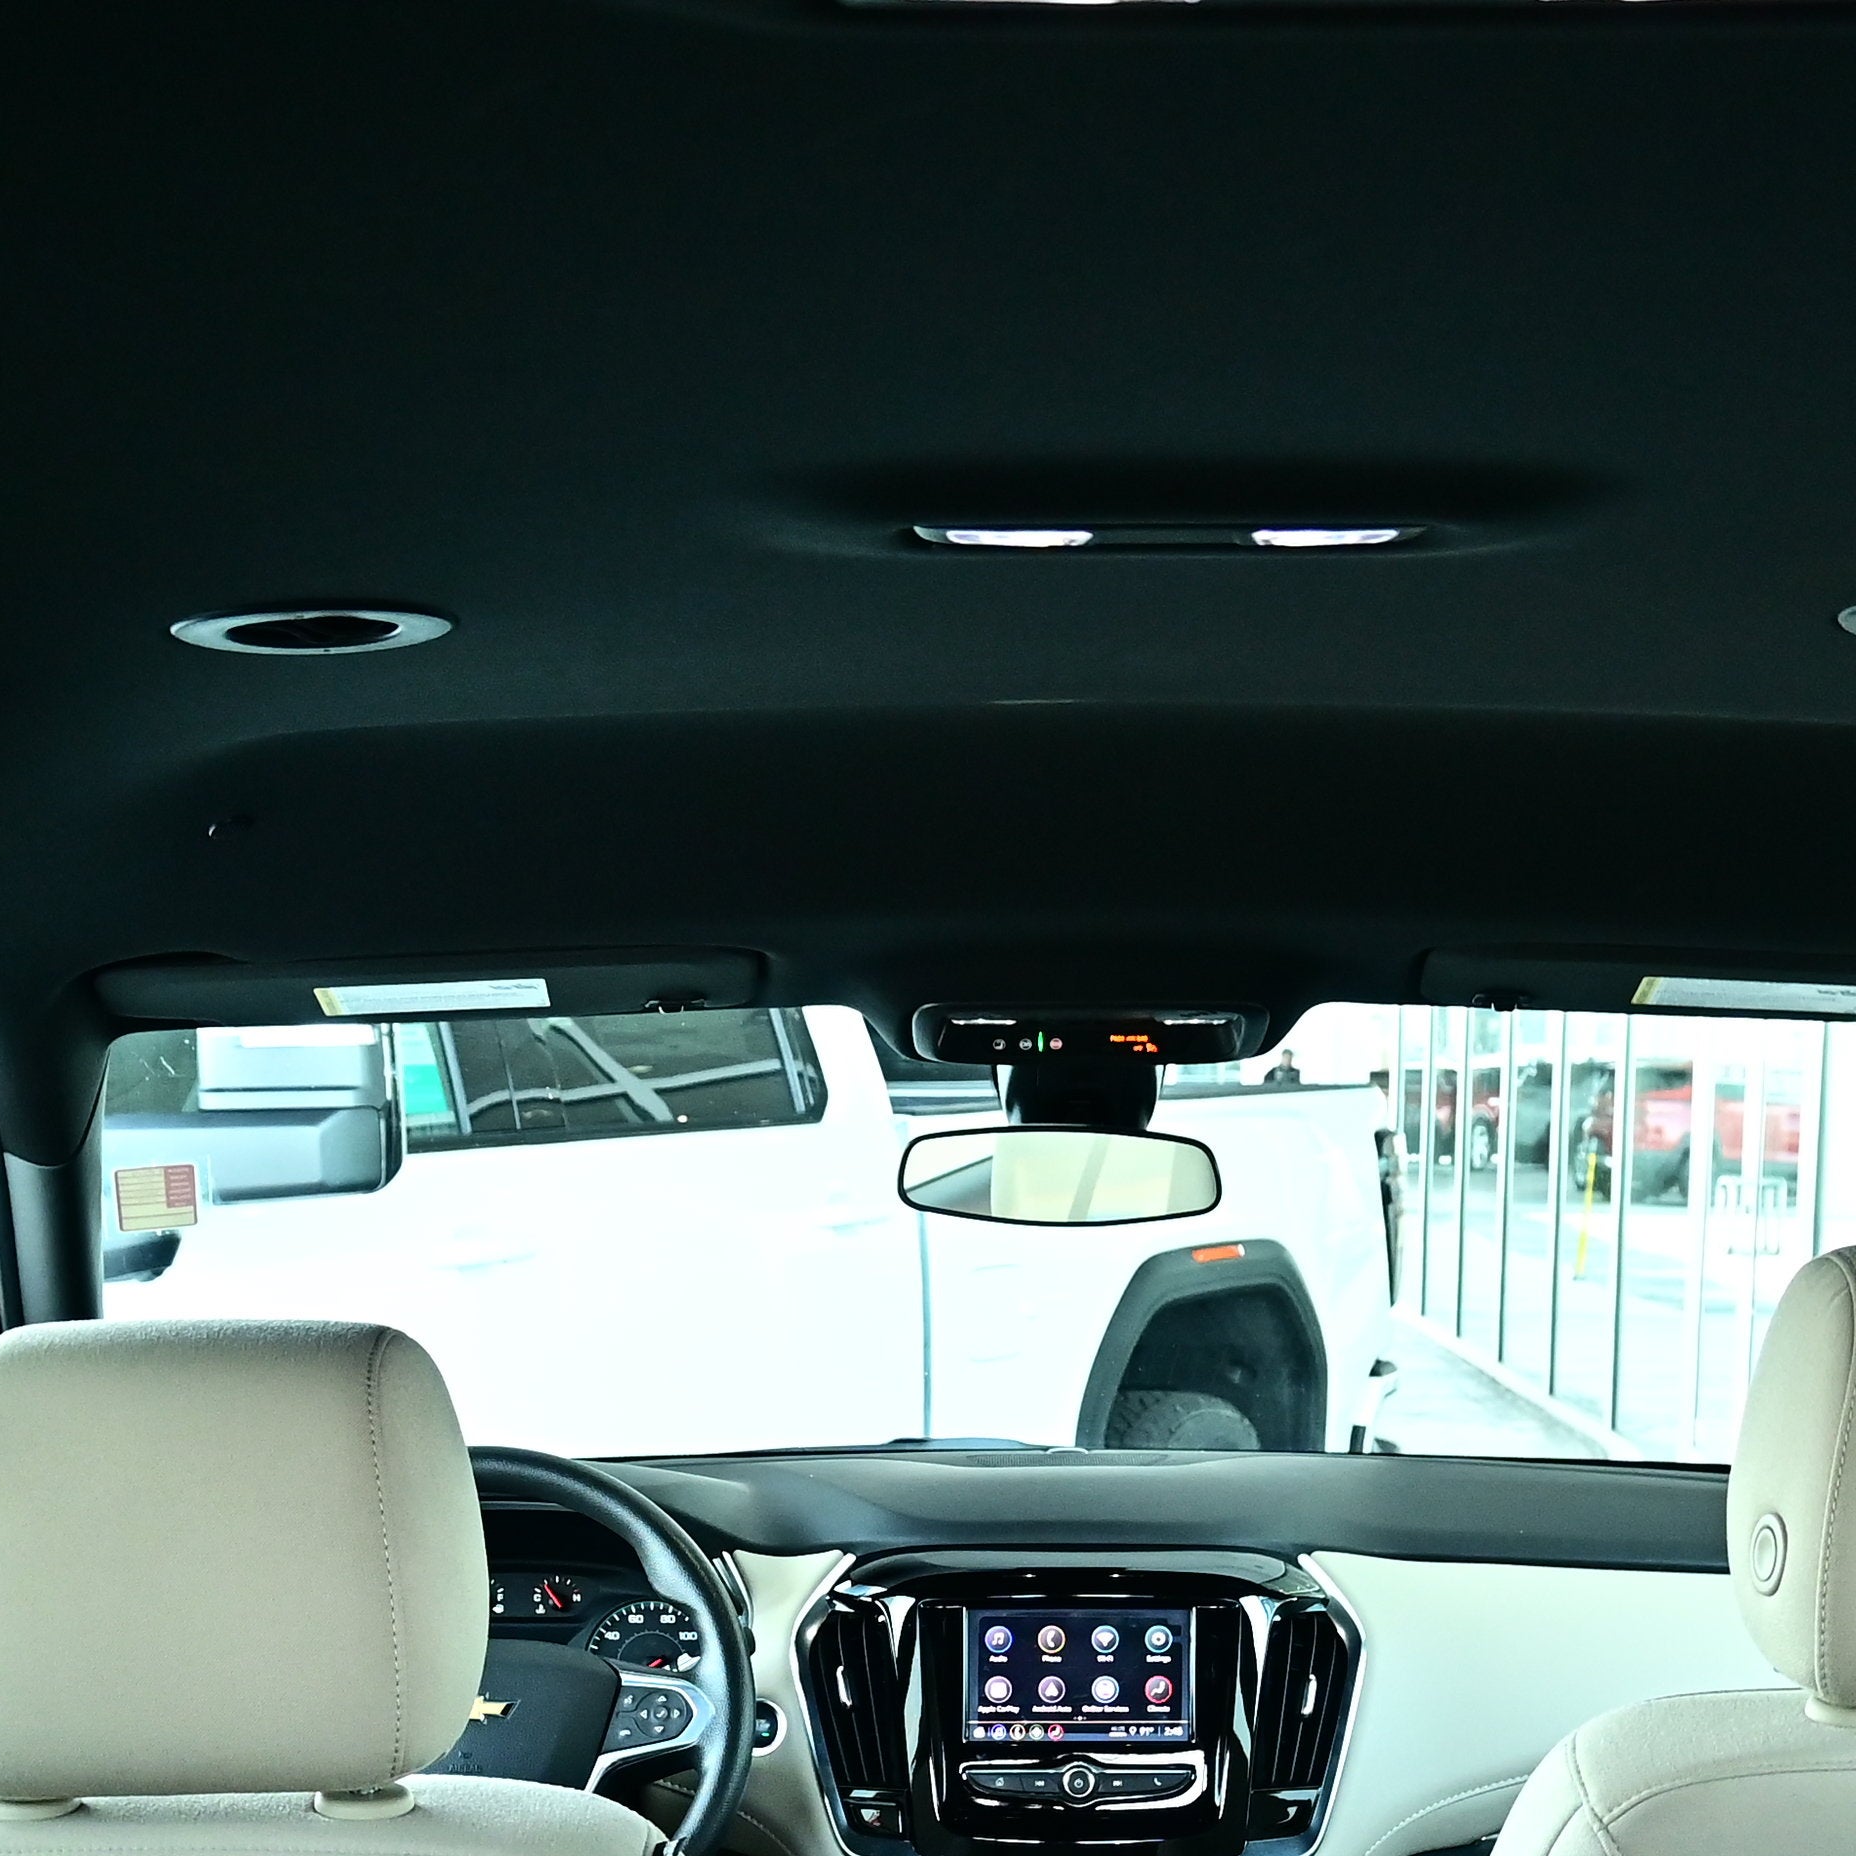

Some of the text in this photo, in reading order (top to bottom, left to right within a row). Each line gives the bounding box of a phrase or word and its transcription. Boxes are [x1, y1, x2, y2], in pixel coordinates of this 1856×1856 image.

[533, 1593, 542, 1602] C
[572, 1593, 582, 1602] H
[628, 1614, 644, 1624] 60
[660, 1614, 676, 1624] 80
[604, 1631, 620, 1640] 40
[678, 1631, 698, 1641] 100
